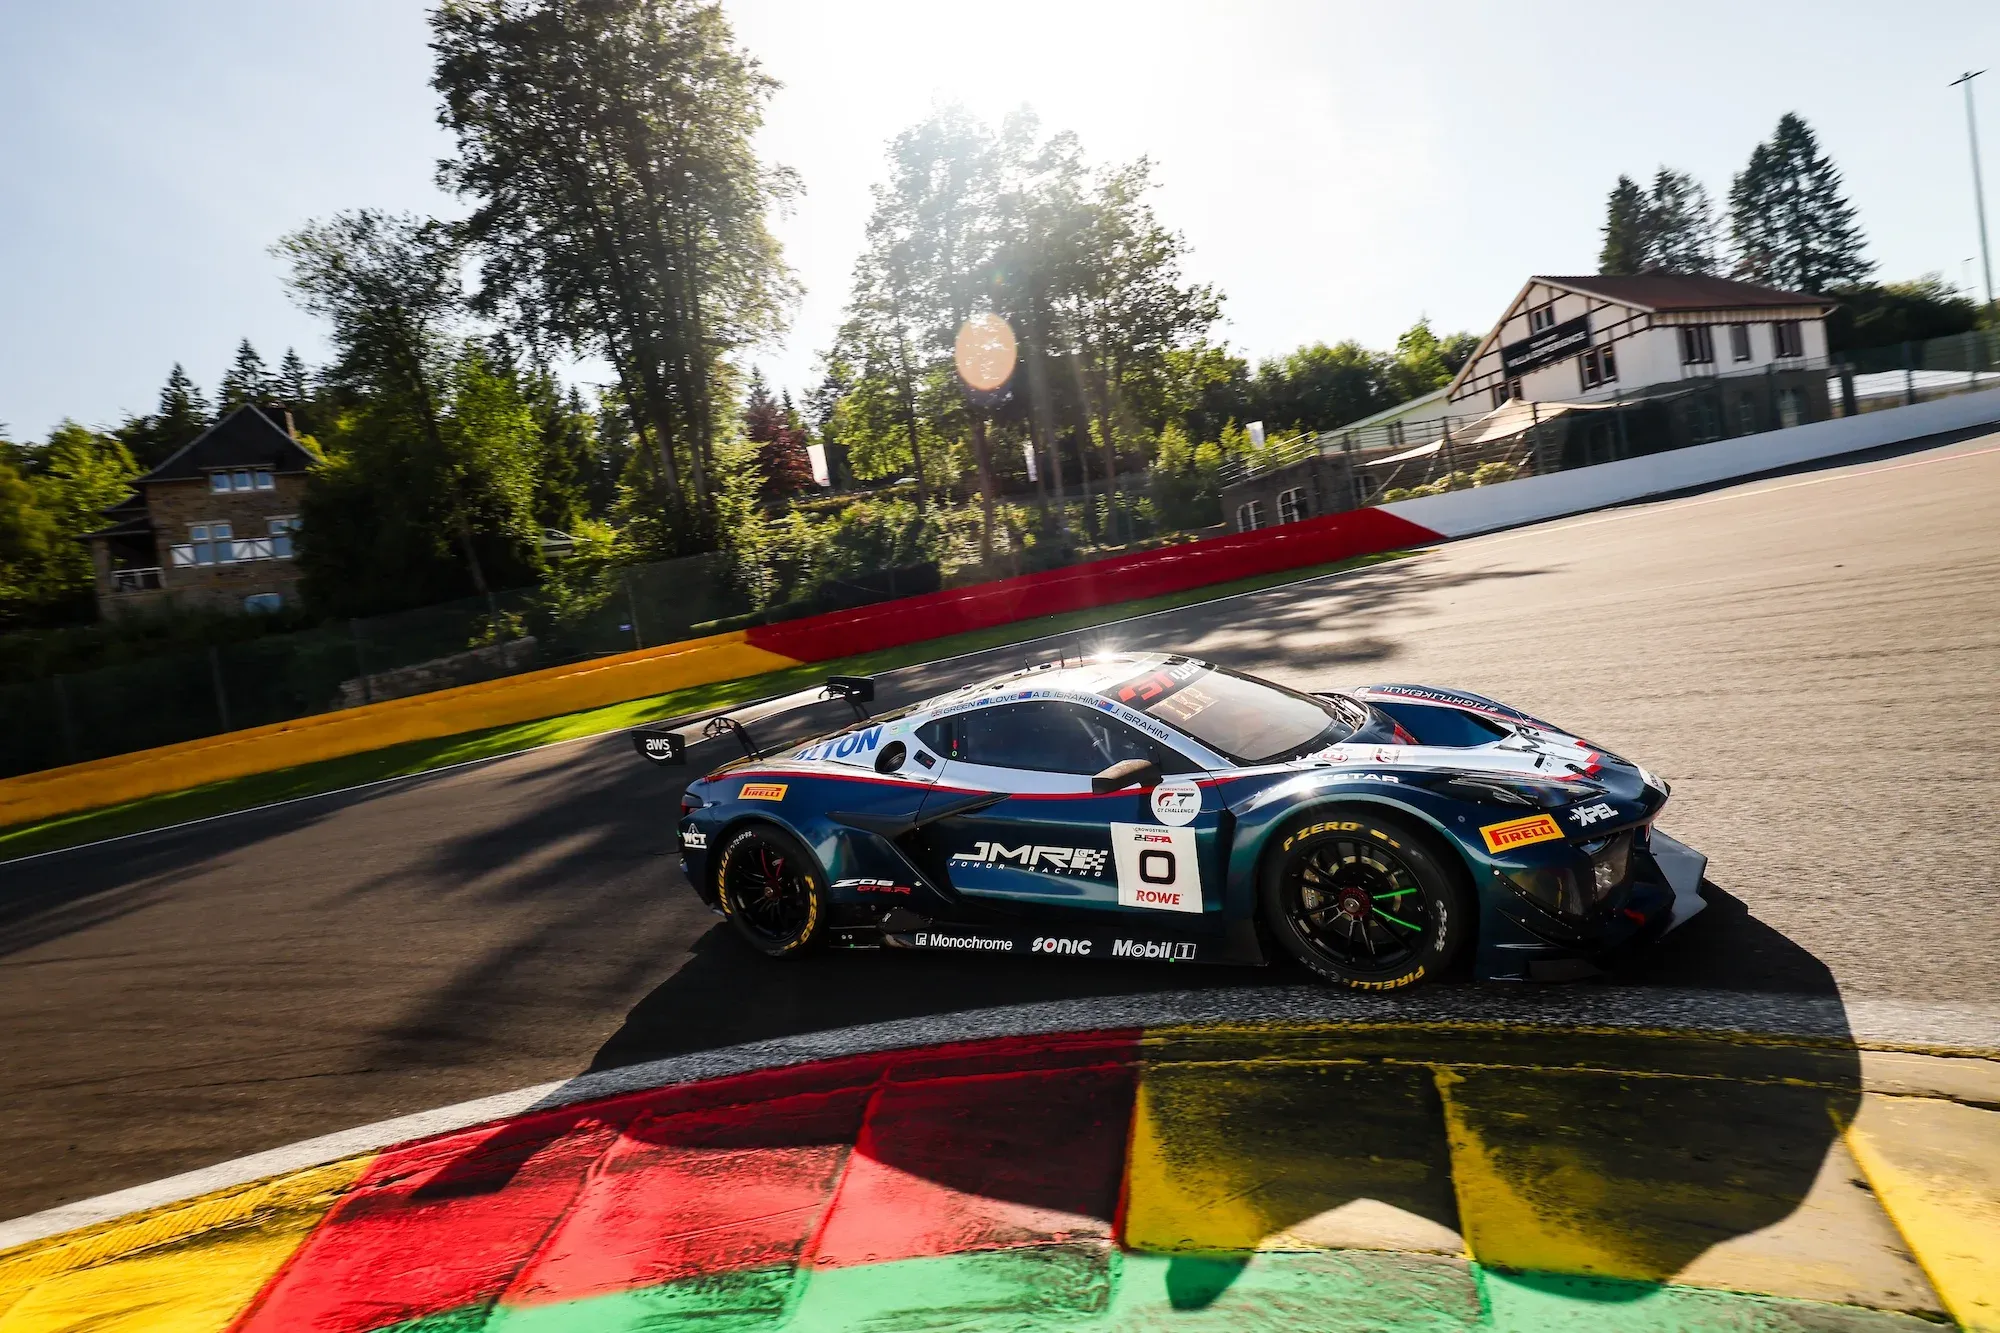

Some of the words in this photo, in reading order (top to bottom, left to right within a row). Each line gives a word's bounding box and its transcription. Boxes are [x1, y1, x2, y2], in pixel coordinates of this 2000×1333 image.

[943, 701, 976, 714] GREEN
[989, 693, 1018, 704] LOVE
[1054, 691, 1099, 707] IBRAHIM
[1110, 708, 1120, 716] J.
[1121, 711, 1170, 741] IBRAHIM
[645, 738, 671, 751] aws
[742, 786, 782, 798] PIRELLI
[1570, 802, 1620, 828] XPEL
[1296, 821, 1361, 841] ZERO
[1488, 819, 1555, 847] PIRELLI
[951, 841, 1073, 869] JMR
[950, 860, 1005, 870] JOHOR
[1028, 866, 1102, 877] RACING
[1139, 849, 1176, 885] 0
[1136, 889, 1181, 905] ROWE
[930, 934, 1013, 950] Monochrome
[1112, 939, 1171, 959] Mobil
[1350, 964, 1426, 991] PIRELLI
